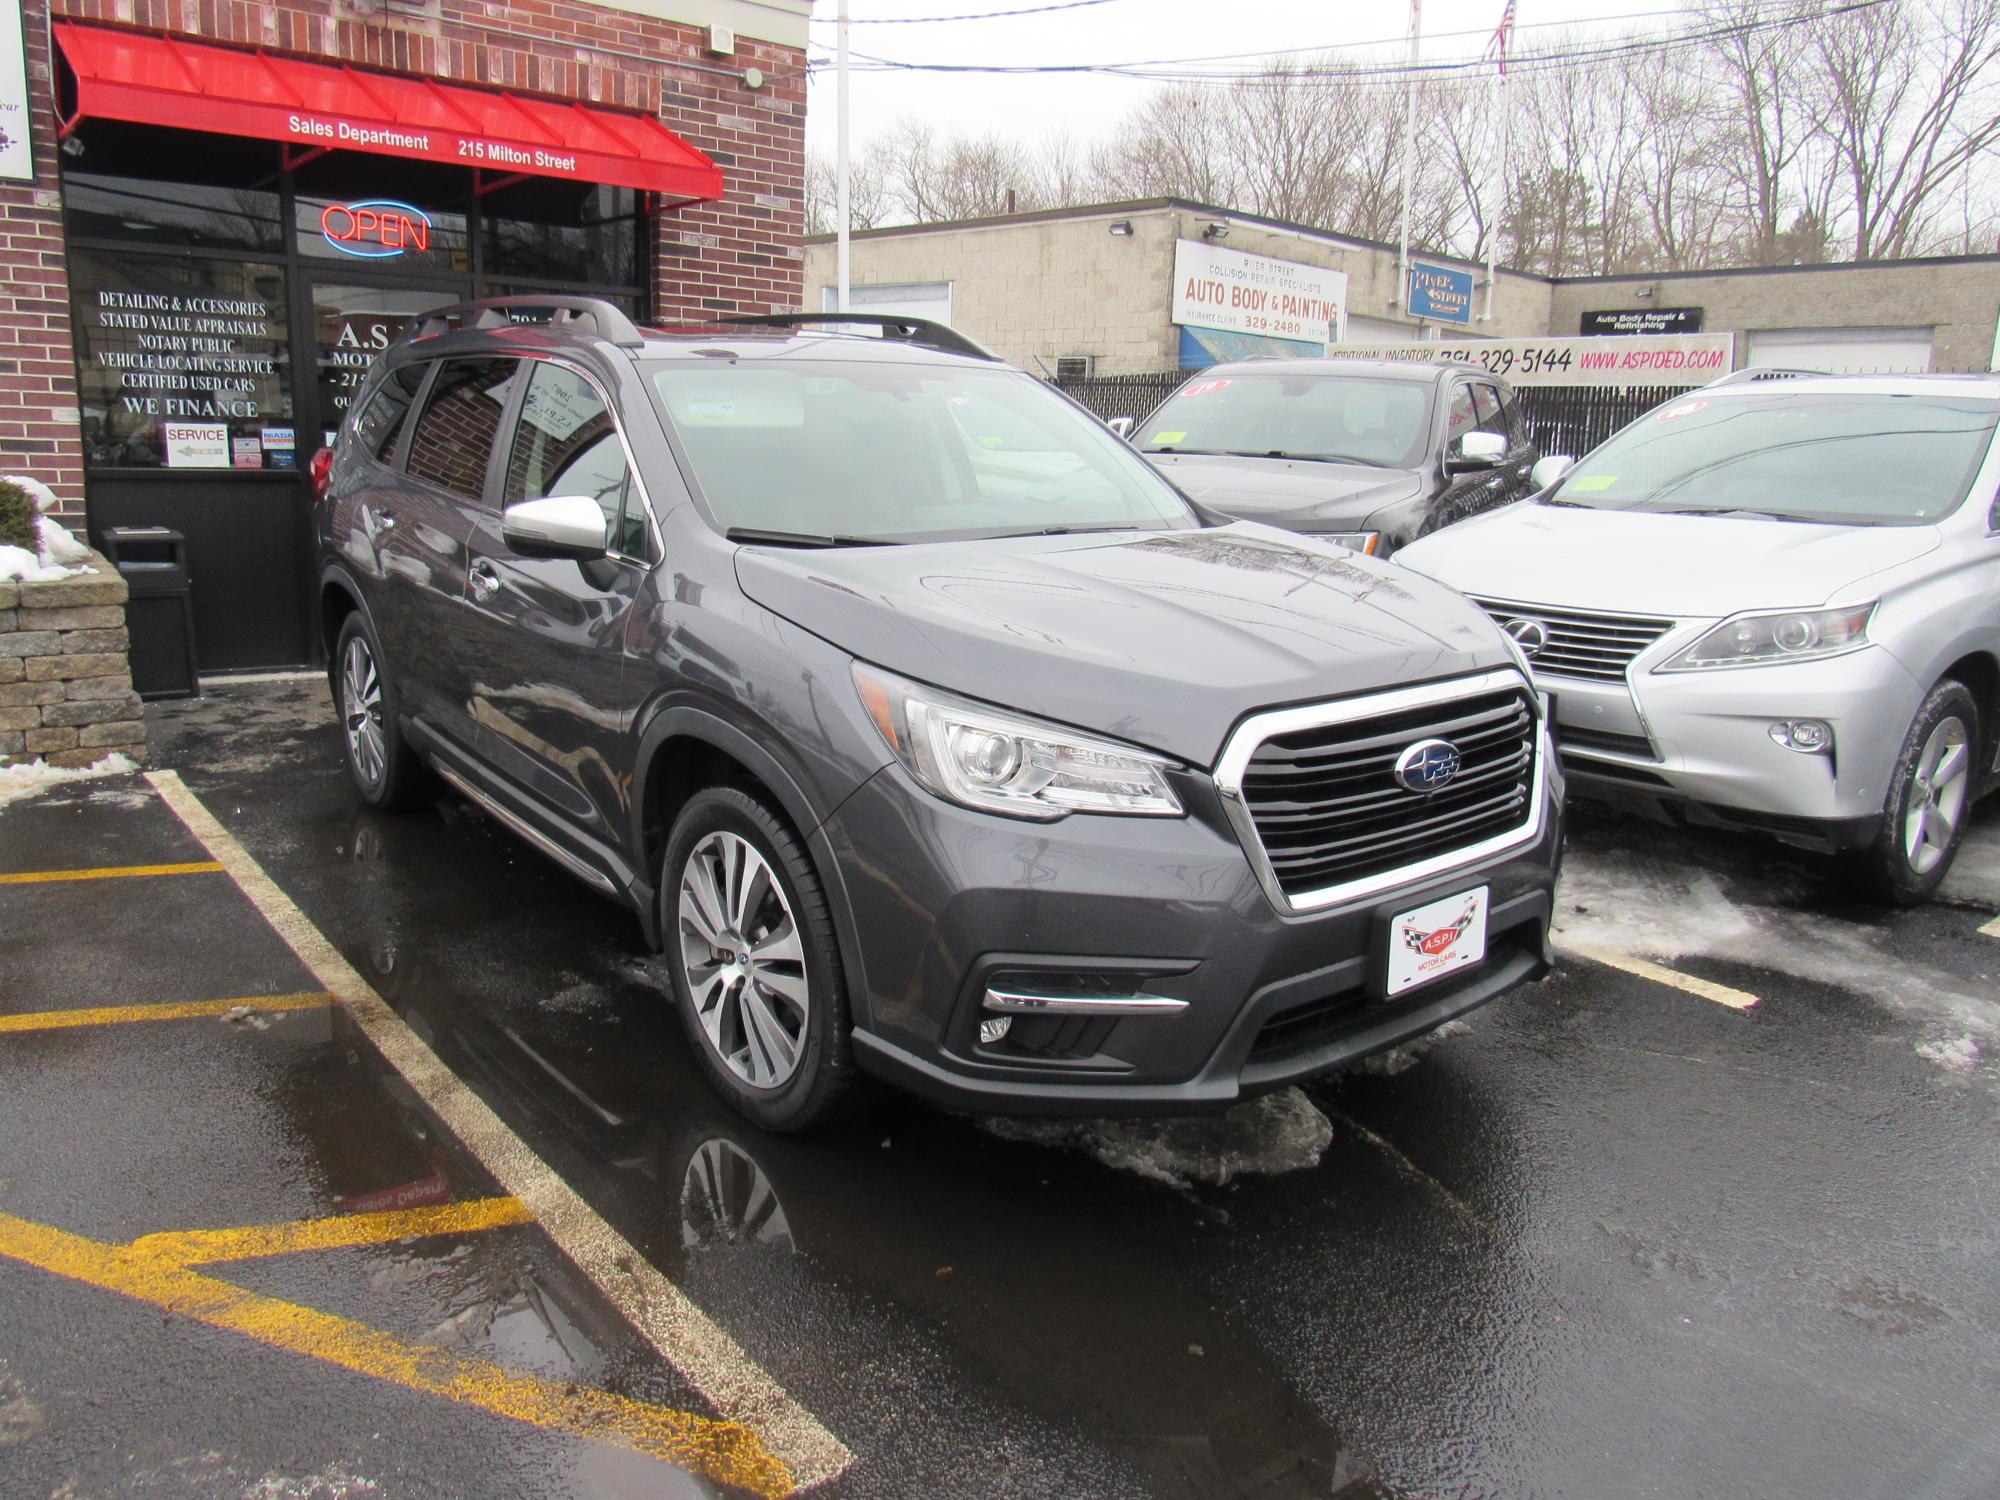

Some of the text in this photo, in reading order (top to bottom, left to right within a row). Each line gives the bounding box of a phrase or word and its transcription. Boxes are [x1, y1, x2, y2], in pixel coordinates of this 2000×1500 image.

[289, 115, 576, 171] Sales Department 215 Milton Street
[321, 204, 430, 251] OPEN
[1209, 264, 1248, 281] COLLISION
[1250, 271, 1276, 286] REPAIR
[1268, 264, 1295, 277] STREET
[100, 291, 266, 317] DETAILING & ACCESSORIES
[1185, 277, 1338, 321] AUTO BODY & PAINTING
[100, 312, 267, 336] STATED VALUE APPRAISALS
[1245, 315, 1300, 334] 329-2480
[1596, 315, 1617, 324] Auto
[1619, 314, 1642, 324] Body
[1645, 313, 1676, 323] Repair
[1613, 321, 1666, 331] Refinishing
[138, 334, 236, 353] NOTARY PUBLIC
[99, 352, 275, 375] VEHICLE LOCATING SERVICE
[1385, 349, 1435, 362] INVENTORY
[1580, 350, 1724, 369] WWW.ASPIDED.COM
[122, 373, 256, 393] CERTIFIED USED CARS
[123, 397, 259, 418] WE FINANCE
[168, 429, 226, 441] SERVICE
[1418, 958, 1440, 972] MOTOR
[1439, 950, 1457, 964] CARS
